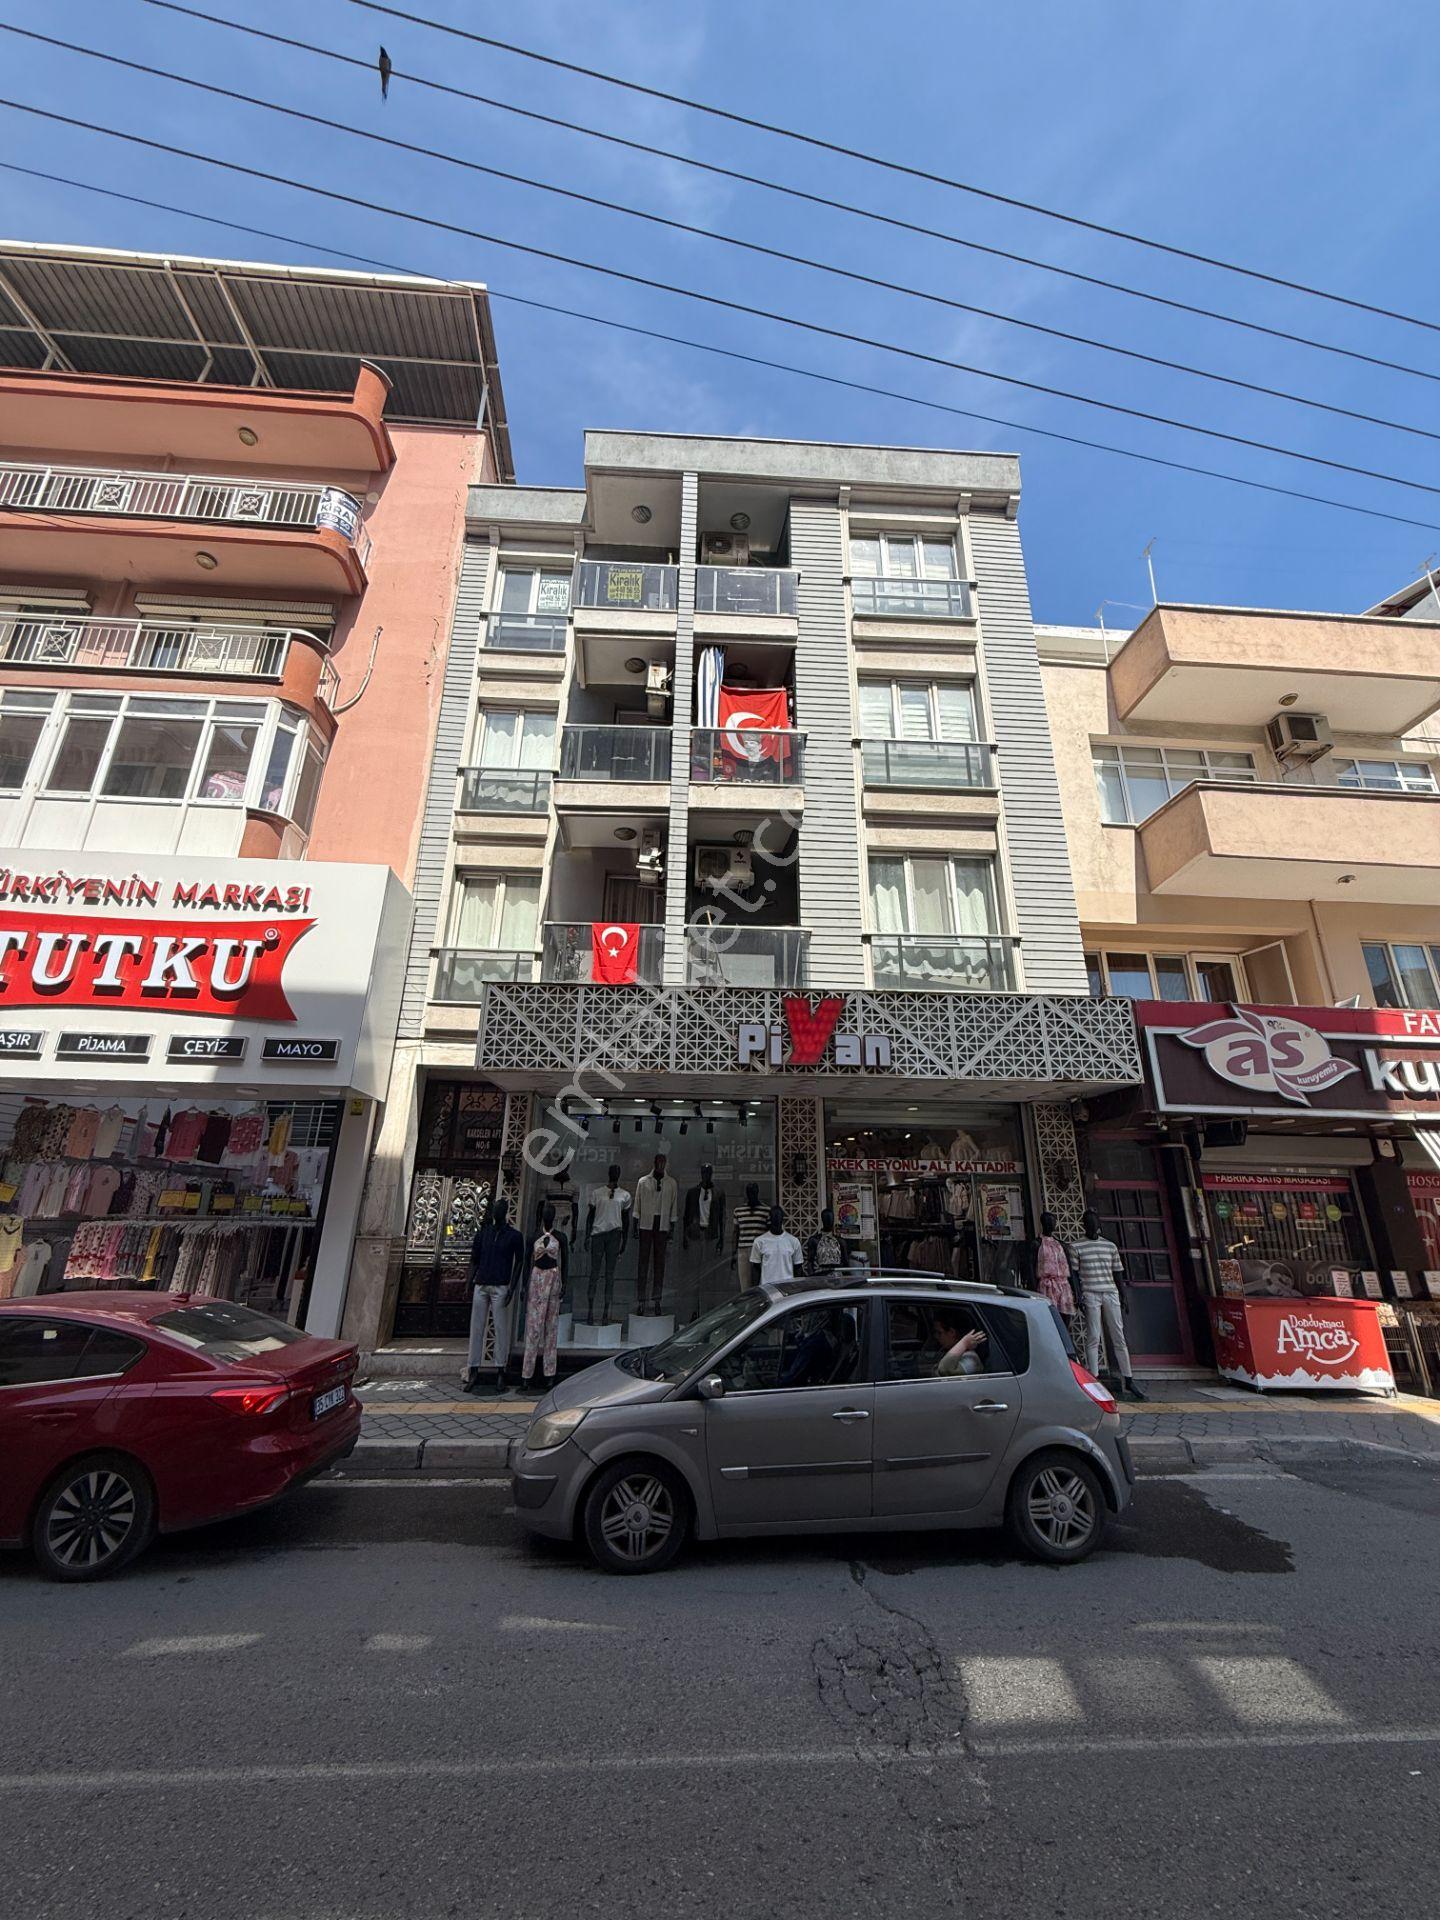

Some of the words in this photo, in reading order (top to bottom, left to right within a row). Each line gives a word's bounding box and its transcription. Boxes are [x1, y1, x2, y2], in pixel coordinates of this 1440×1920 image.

[609, 573, 640, 586] Kiralık
[541, 584, 567, 595] Kiralık
[172, 881, 312, 908] MARKASI
[1403, 1012, 1440, 1034] FA
[78, 1037, 126, 1052] PİJAMA
[183, 1039, 228, 1055] ÇEYİZ
[277, 1043, 323, 1056] MAYO
[1226, 1031, 1304, 1076] as
[1296, 1062, 1338, 1085] kuruyemiş
[1363, 1047, 1440, 1092] ku
[826, 1158, 865, 1171] RKEK
[867, 1159, 920, 1171] REYONU
[929, 1160, 952, 1172] ALT
[955, 1161, 1016, 1173] KATTADIR
[1277, 1319, 1349, 1353] Amca
